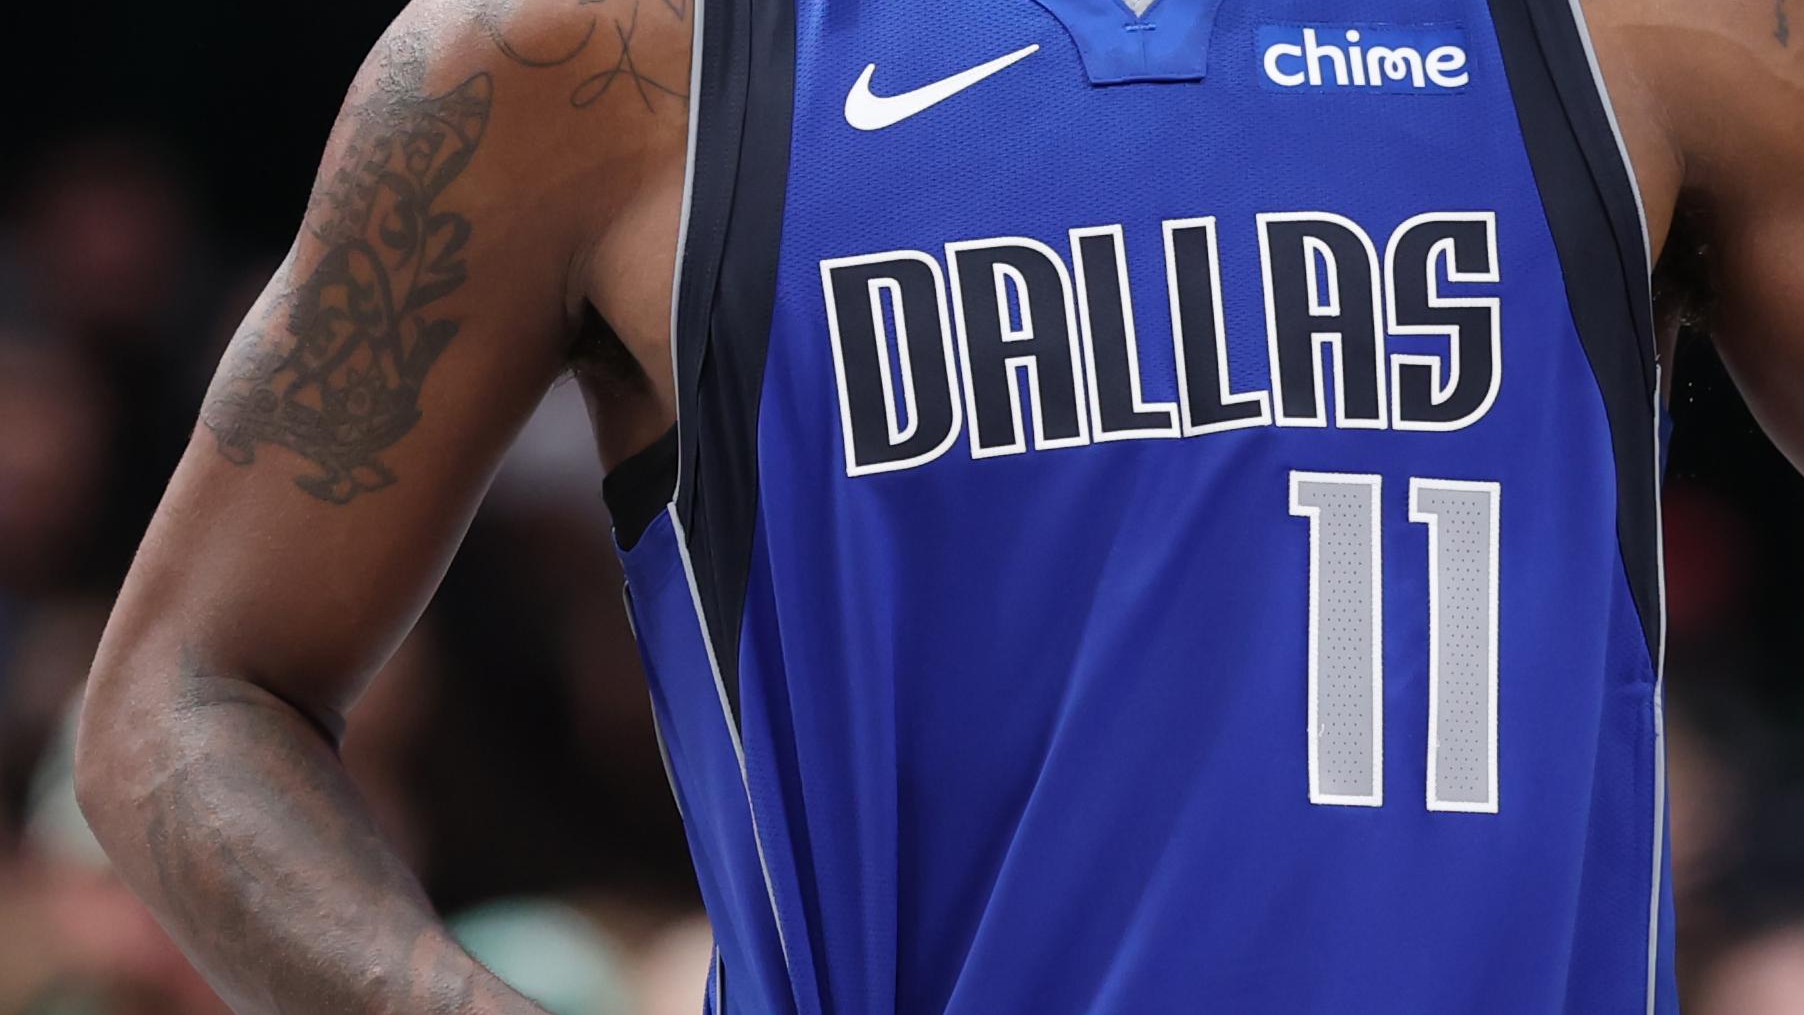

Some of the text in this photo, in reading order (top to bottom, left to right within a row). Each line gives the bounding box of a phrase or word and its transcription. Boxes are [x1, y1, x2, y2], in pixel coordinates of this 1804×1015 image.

[1264, 29, 1470, 88] chime
[819, 212, 1501, 477] DALLAS
[1289, 470, 1501, 814] 11
